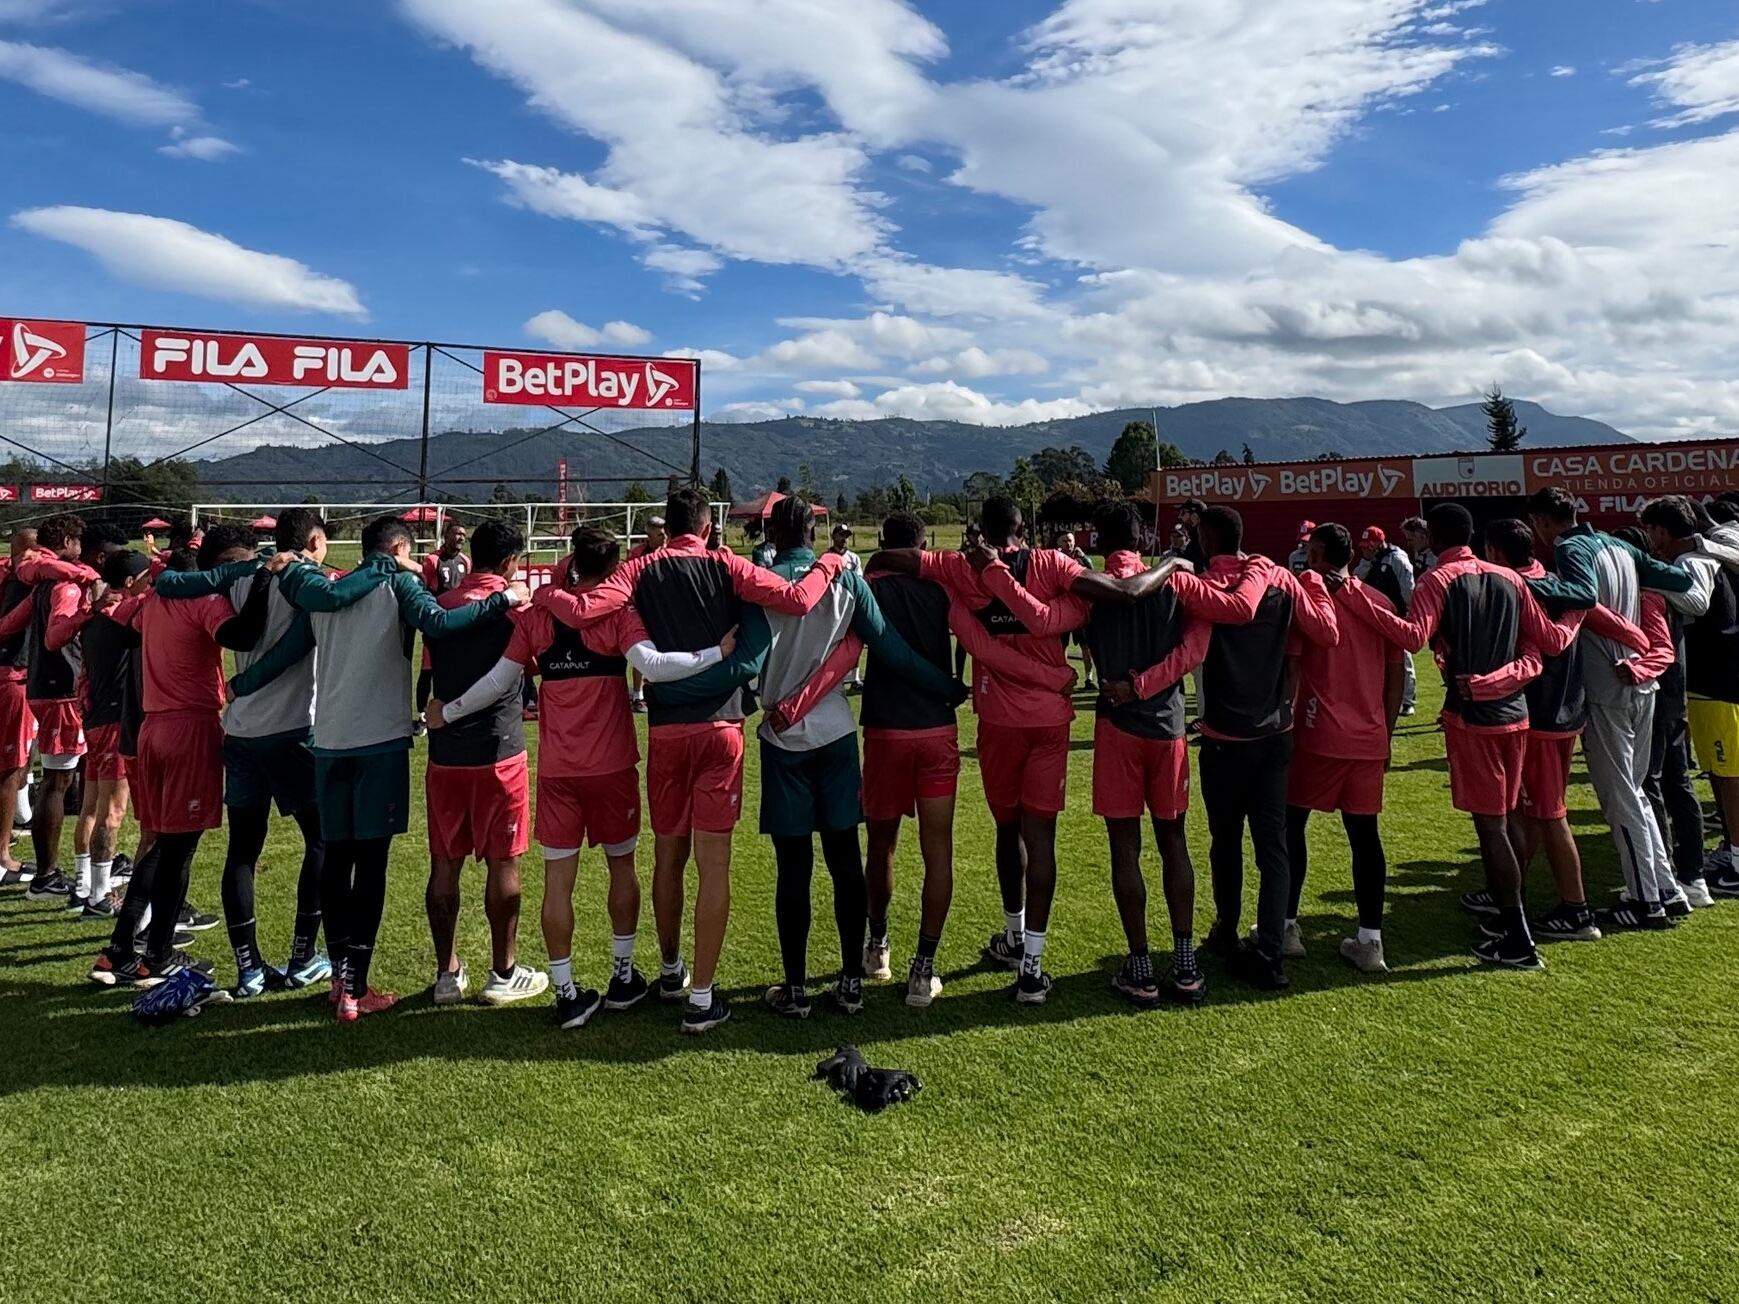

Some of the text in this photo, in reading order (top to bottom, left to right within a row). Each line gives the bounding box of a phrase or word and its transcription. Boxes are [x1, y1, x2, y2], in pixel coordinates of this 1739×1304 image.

[153, 337, 398, 383] FILA FILA
[499, 358, 640, 406] BetPlay
[1532, 454, 1604, 477] CASA
[36, 487, 82, 500] BetPlay
[1166, 466, 1374, 500] BetPlay BetPlay
[1420, 480, 1522, 497] AUDITORIO
[1564, 474, 1735, 491] TIENDA OFICIAL
[549, 661, 590, 669] CATAPULT
[1305, 697, 1318, 729] FILA
